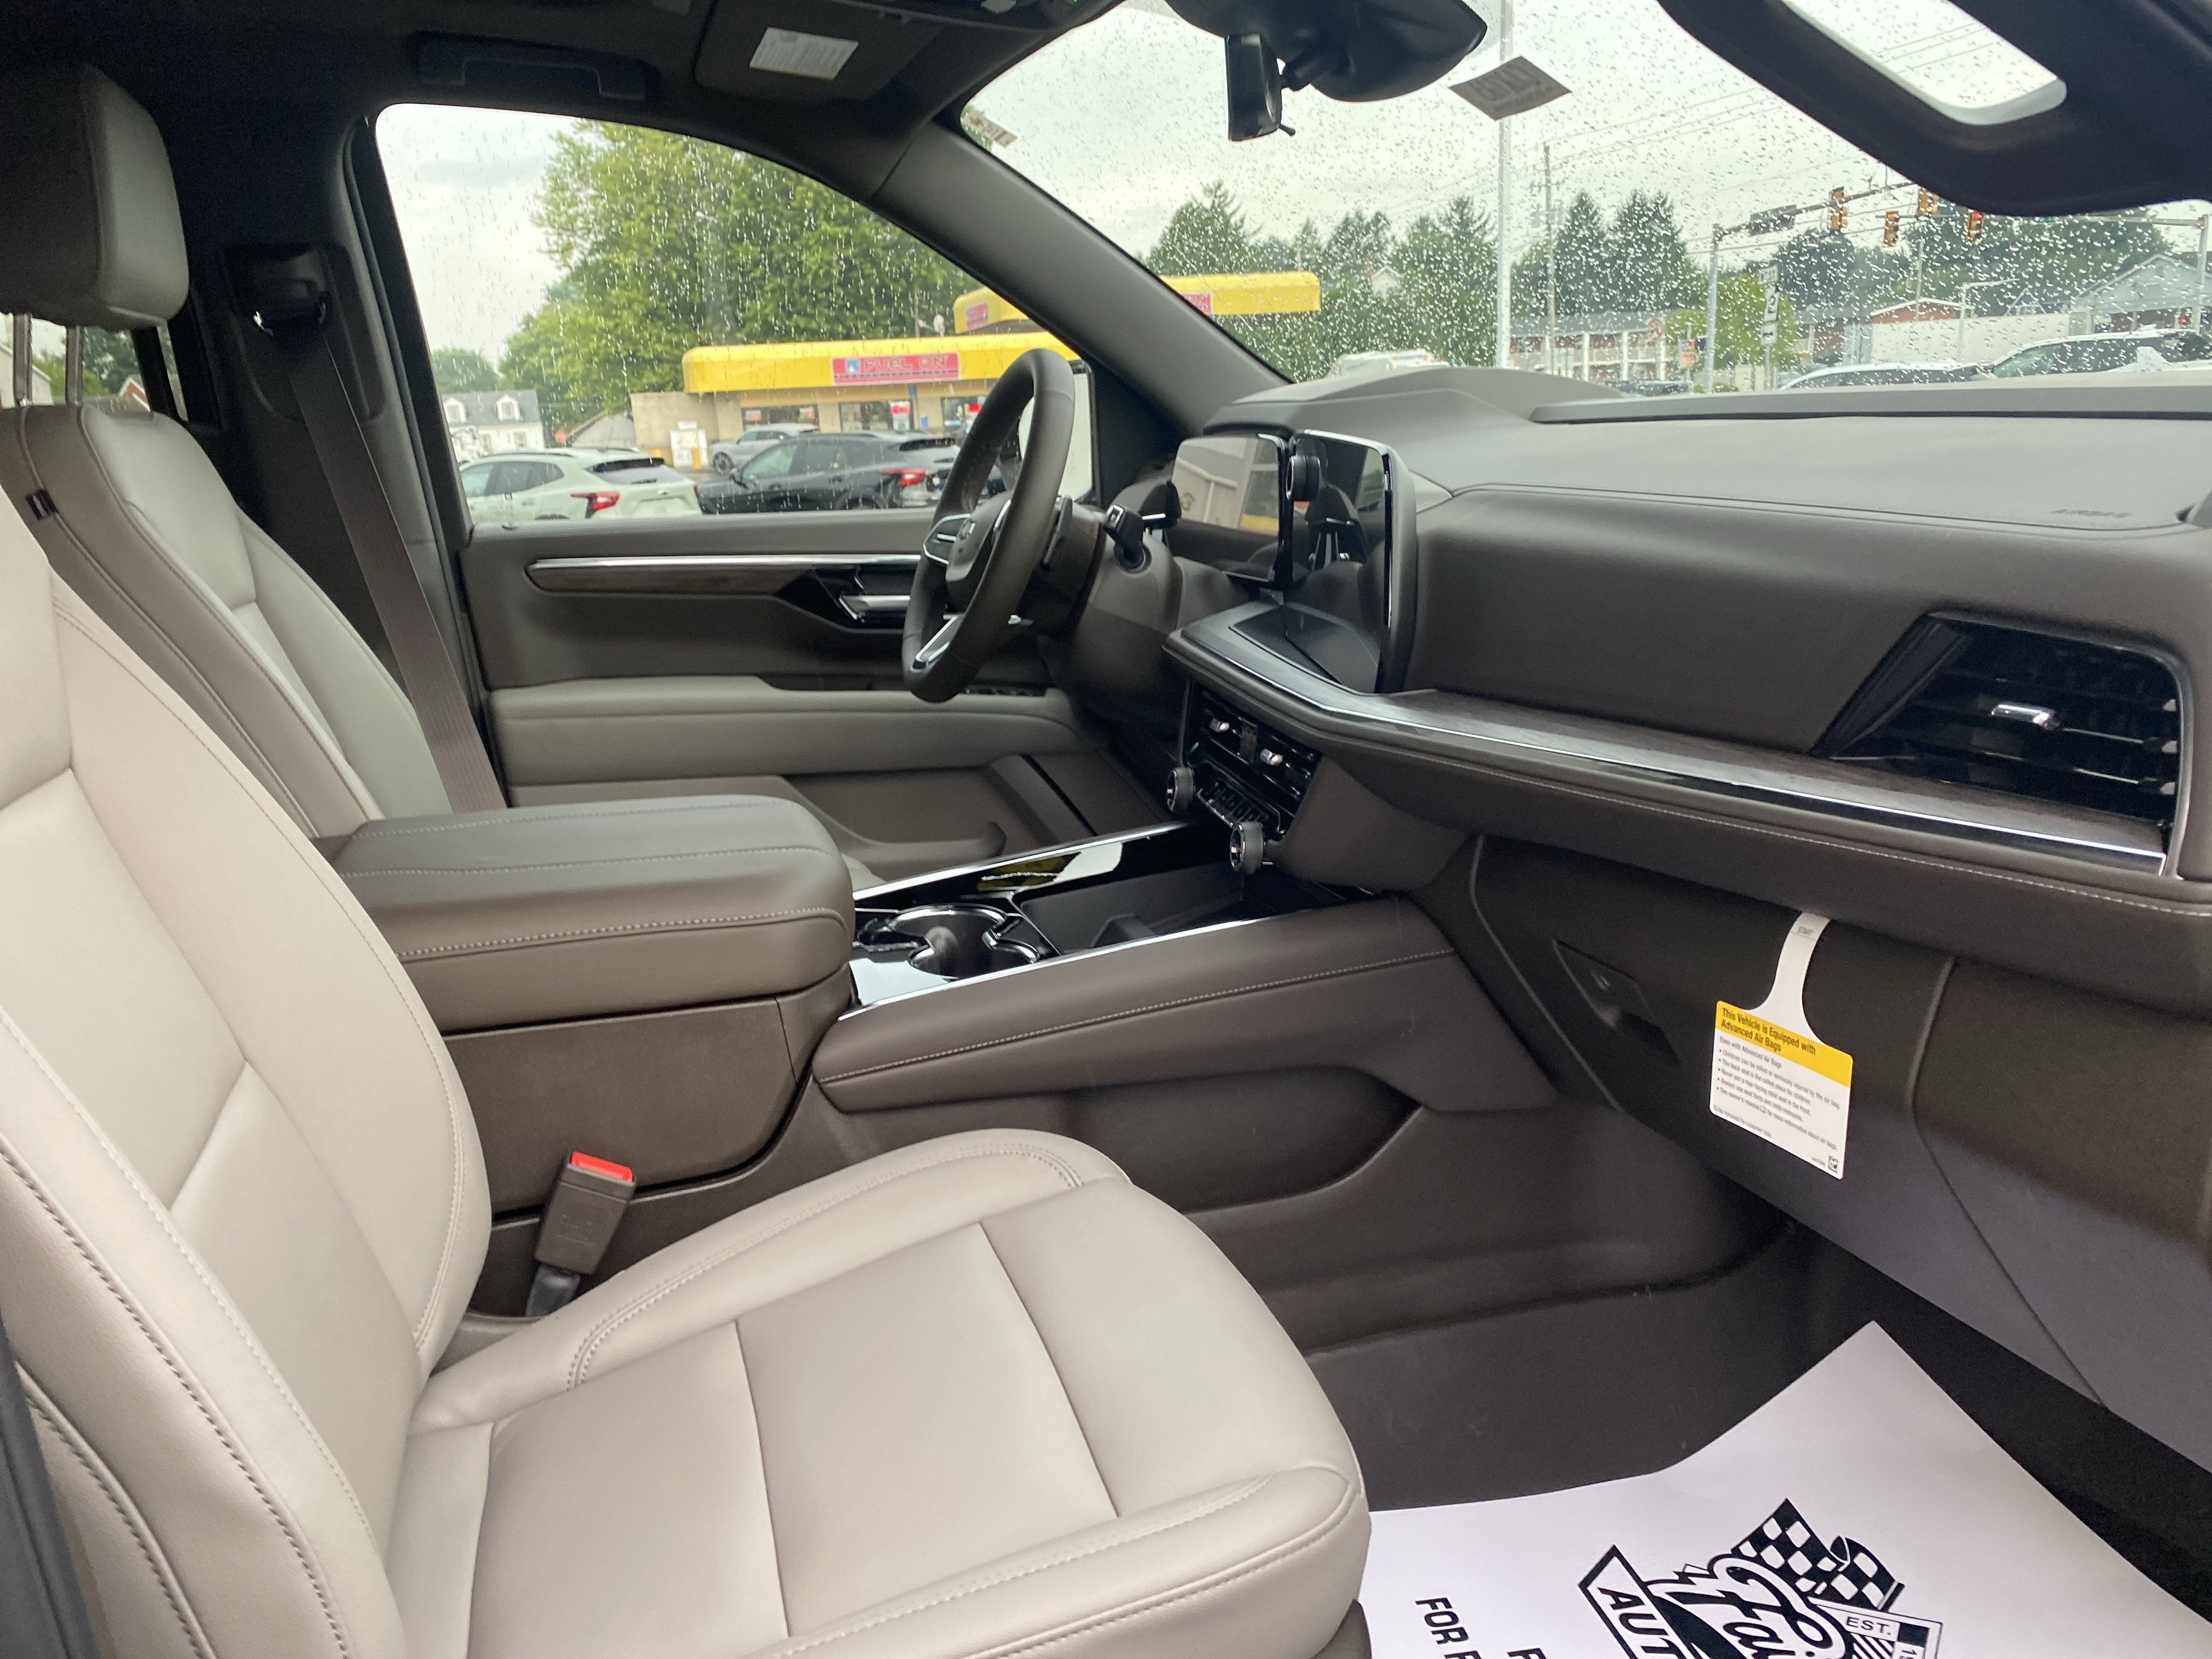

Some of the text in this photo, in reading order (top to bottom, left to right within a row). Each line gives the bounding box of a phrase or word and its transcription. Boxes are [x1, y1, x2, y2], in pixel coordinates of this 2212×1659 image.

[864, 355, 949, 371] FUEL ON
[1721, 1019, 1781, 1052] Advanced Air Bags
[1722, 1007, 1816, 1054] This Vehicle is Equipped with
[1415, 1597, 1470, 1645] FOR
[1846, 1616, 1892, 1636] EST.
